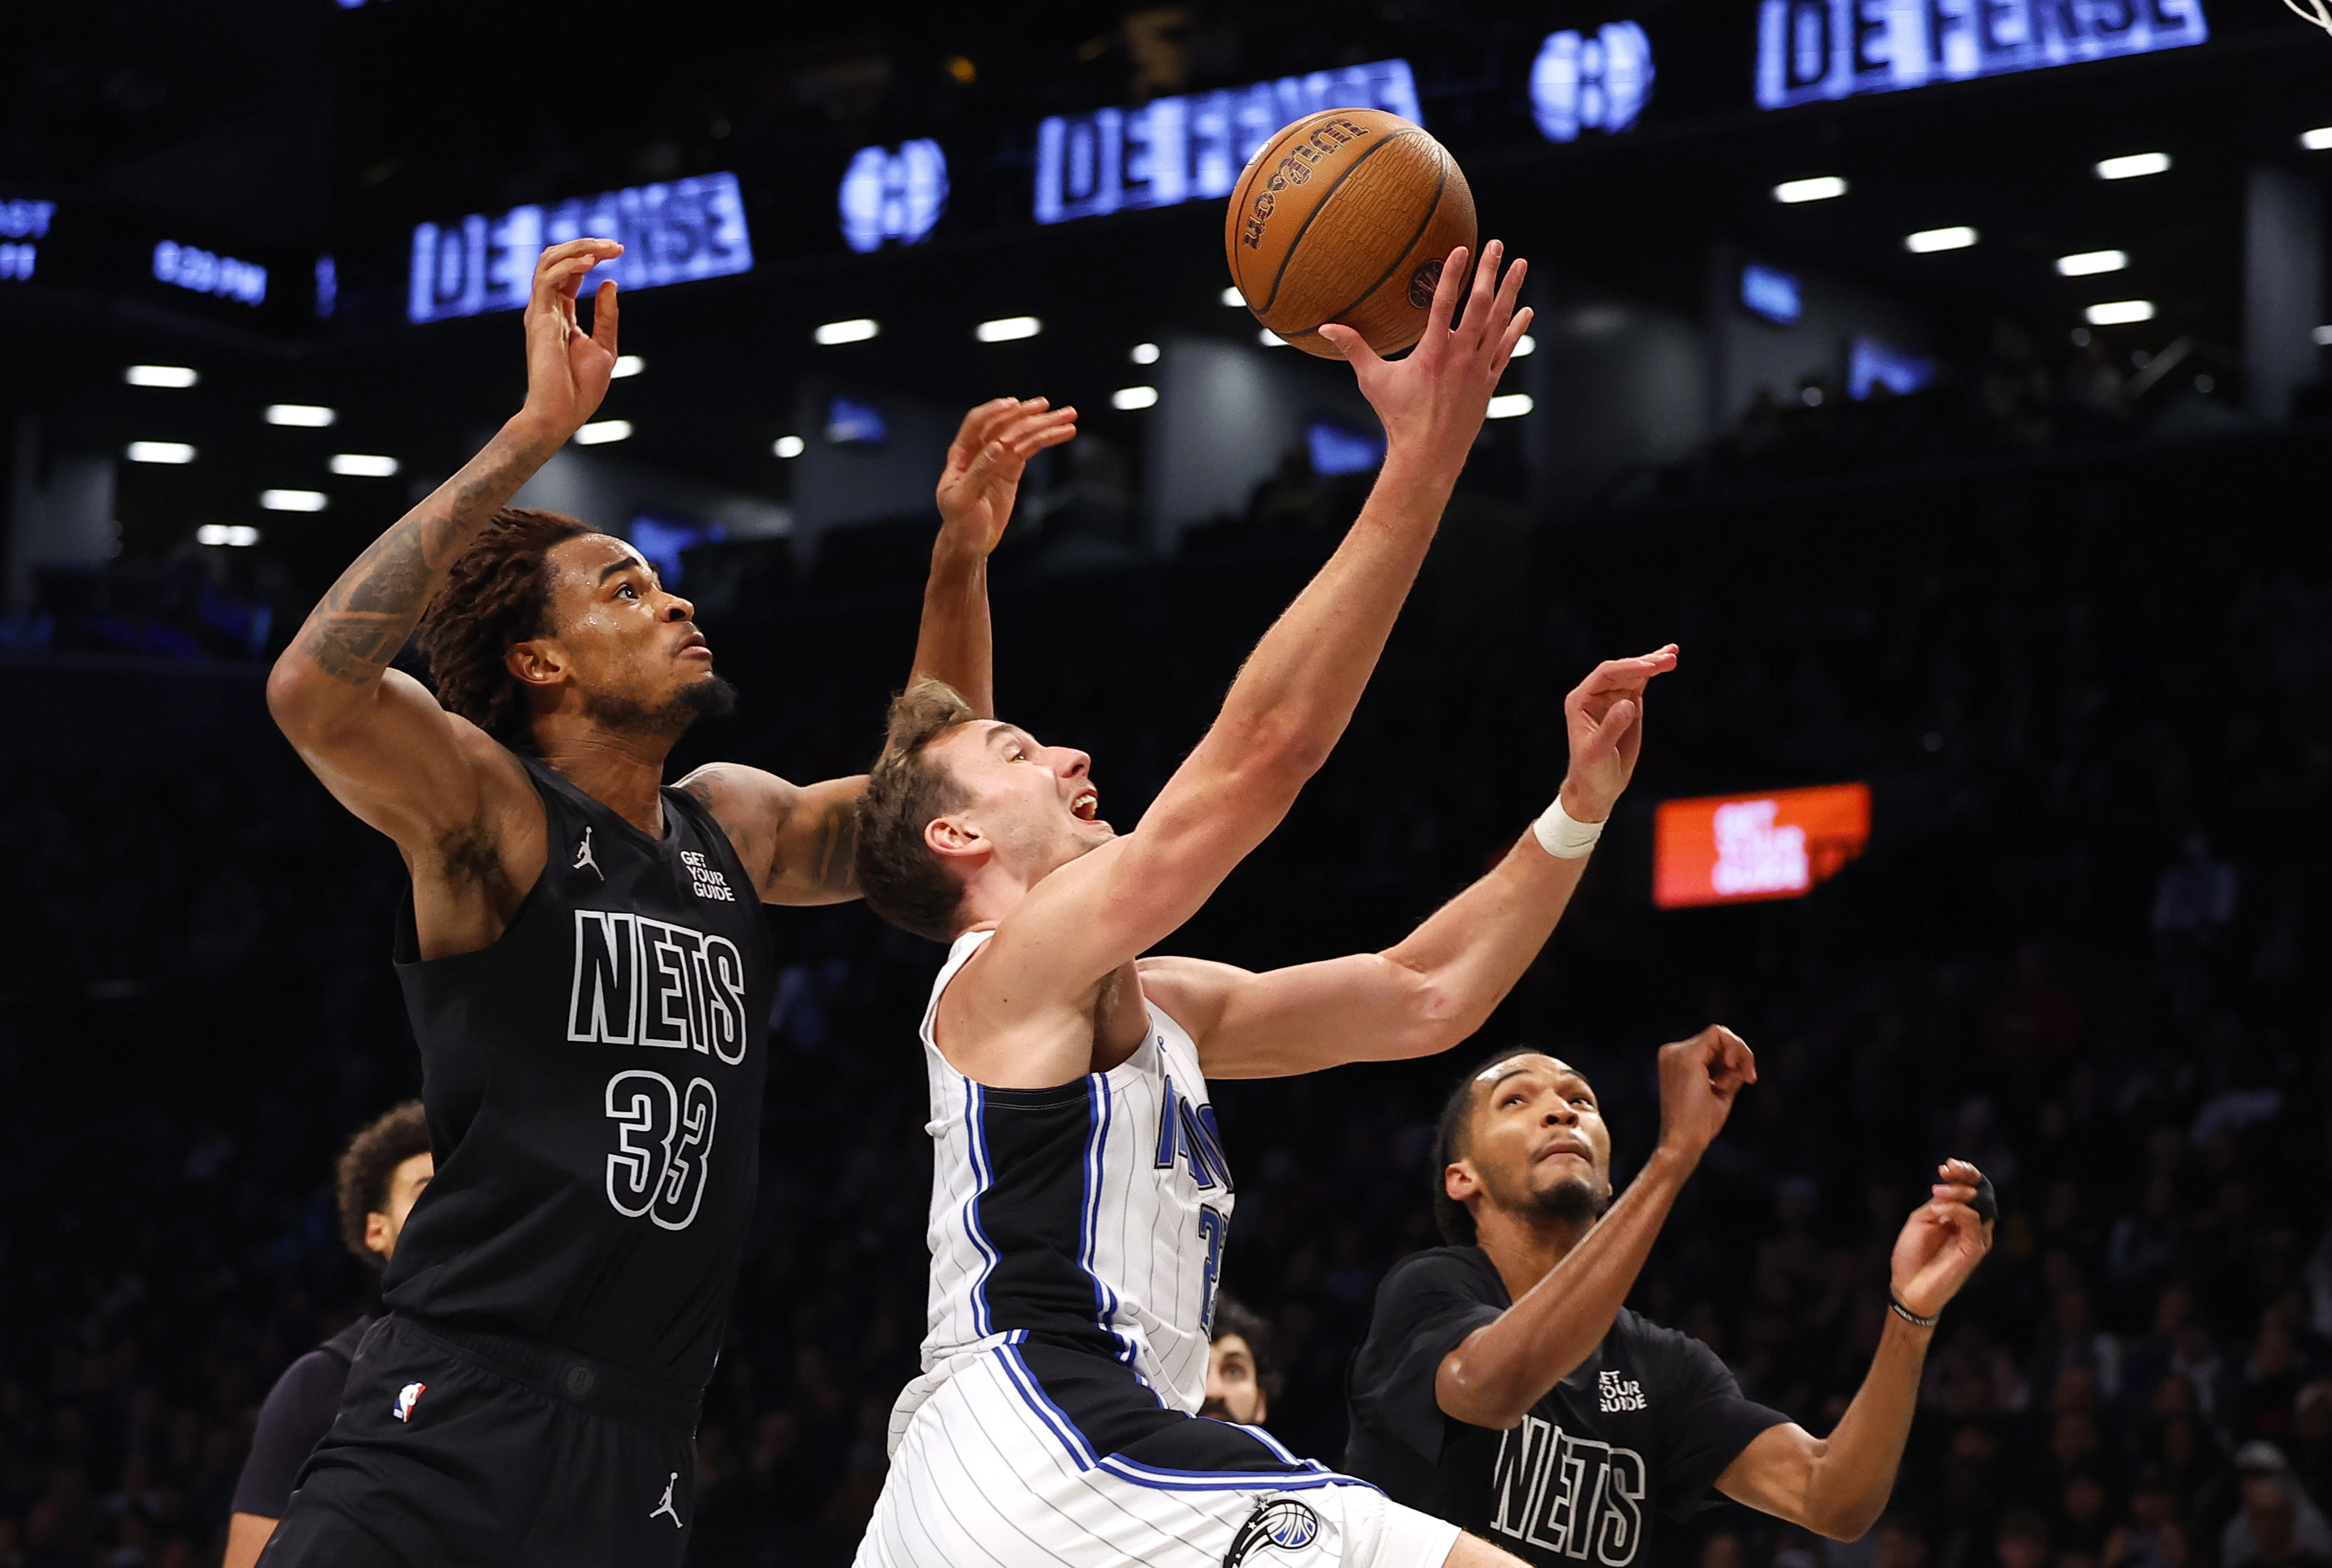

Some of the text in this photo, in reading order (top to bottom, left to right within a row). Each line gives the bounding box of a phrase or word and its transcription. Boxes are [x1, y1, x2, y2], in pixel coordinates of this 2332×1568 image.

[680, 851, 706, 868] GET
[686, 866, 727, 886] YOUR
[693, 881, 735, 901] GUIDE
[567, 910, 747, 1066] NETS
[605, 1070, 717, 1231] 33
[1599, 1370, 1620, 1385] ET
[1599, 1380, 1641, 1399] OUR
[1490, 1414, 1646, 1567] NETS
